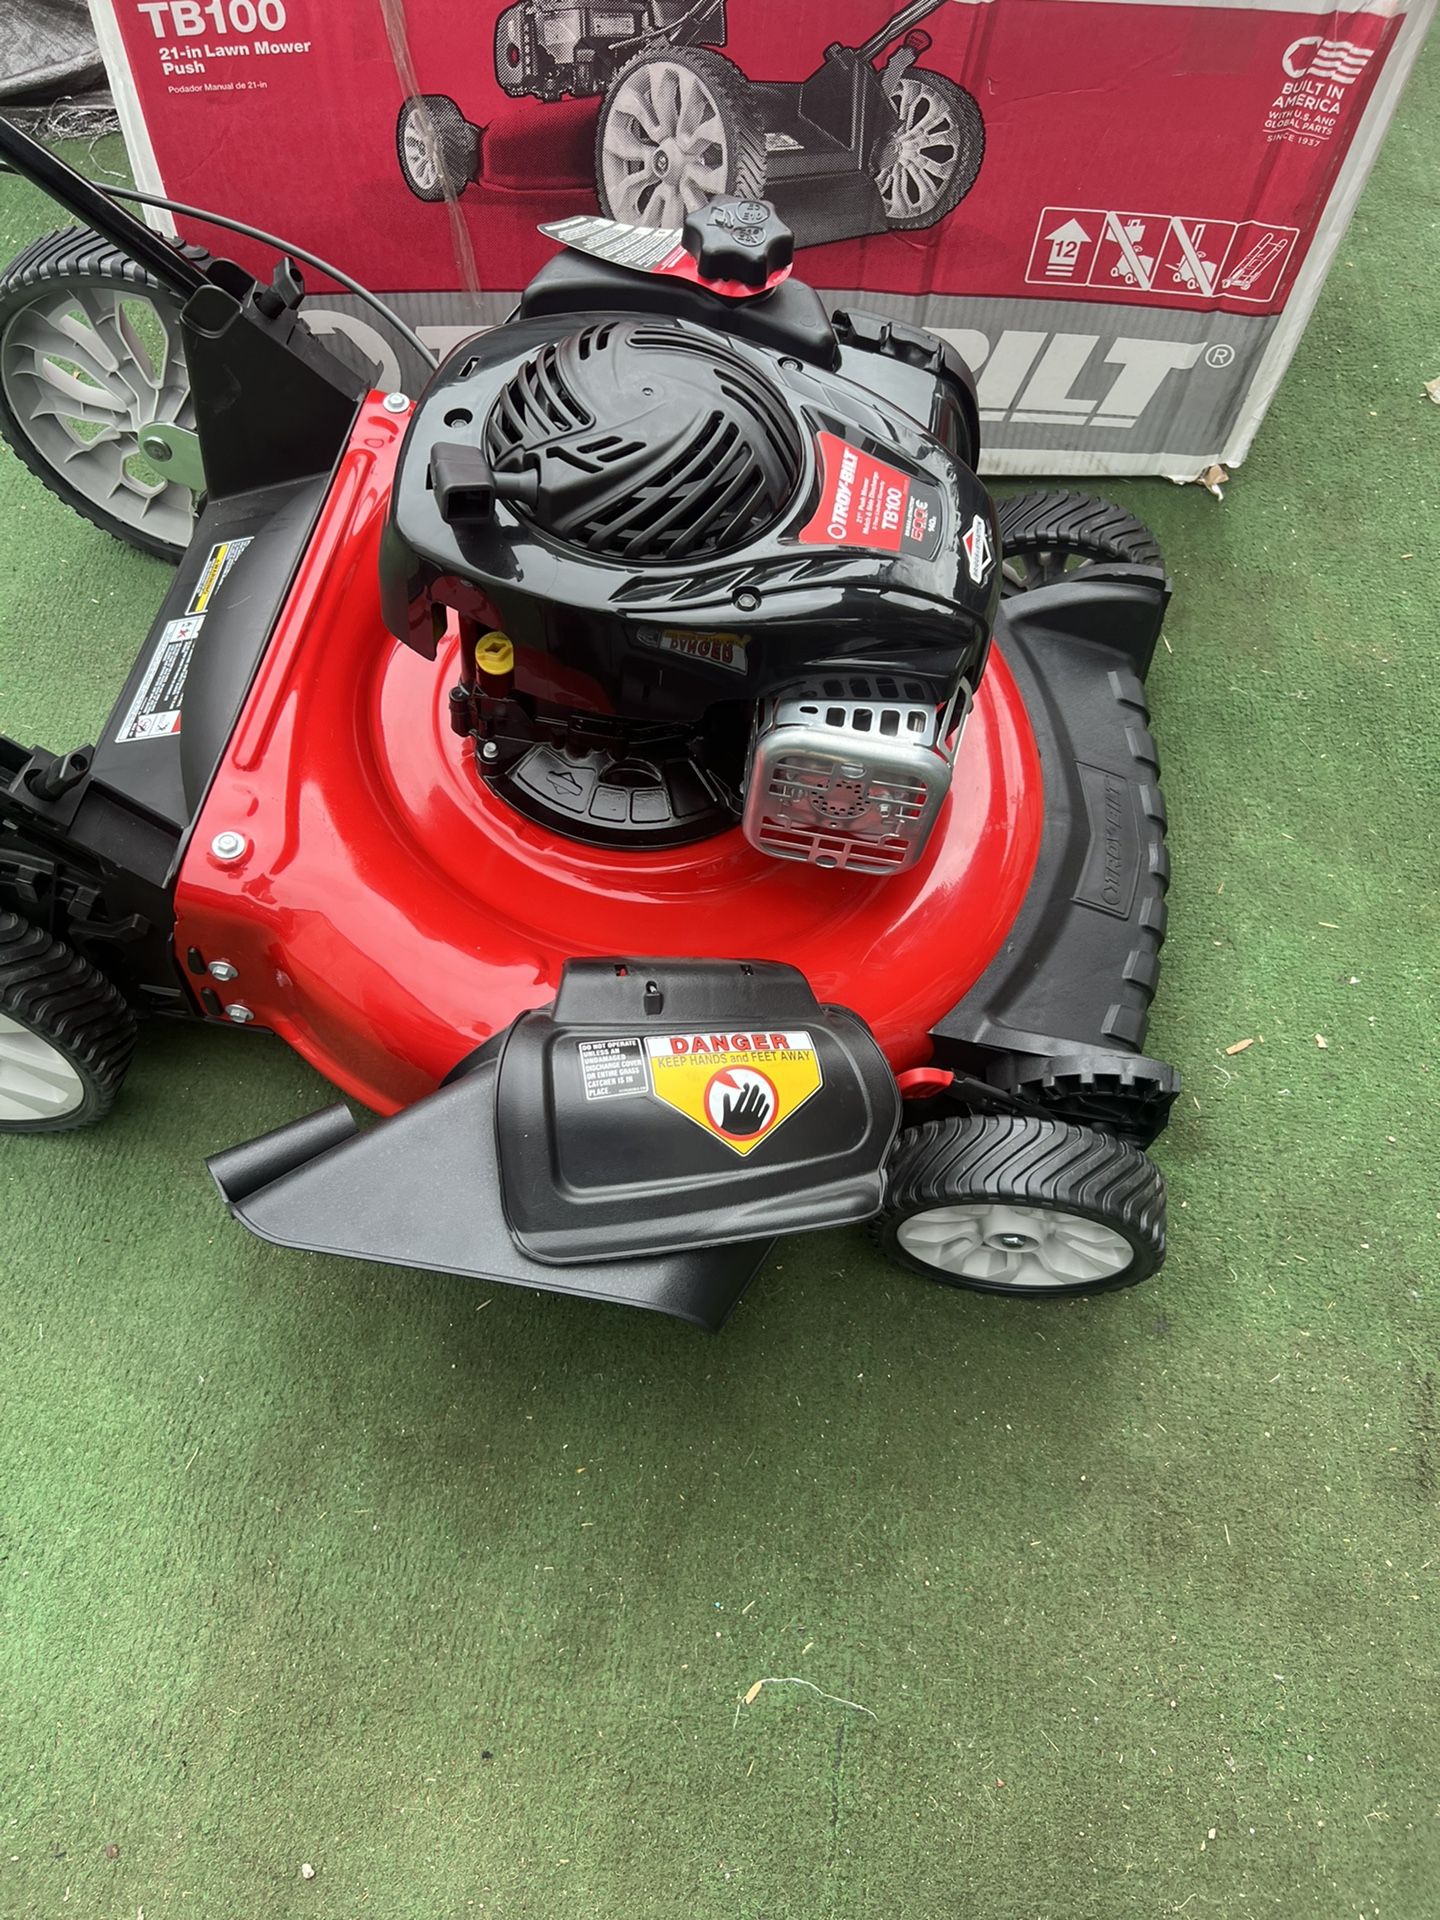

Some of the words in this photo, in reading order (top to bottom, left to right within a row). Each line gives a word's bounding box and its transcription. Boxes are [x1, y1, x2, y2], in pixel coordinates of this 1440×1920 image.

[137, 0, 287, 38] TB100
[159, 44, 202, 61] 21-in
[205, 44, 250, 58] Lawn
[254, 41, 311, 55] Mower
[162, 61, 206, 76] Push
[168, 84, 203, 94] Podador
[204, 82, 234, 92] Manual
[235, 82, 246, 90] de
[247, 81, 268, 89] 21-in
[1282, 79, 1325, 96] BUILT
[1326, 83, 1345, 100] IN
[1272, 94, 1341, 114] AMERICA
[1268, 110, 1293, 119] WITH
[1293, 109, 1311, 121] U.S.
[1313, 115, 1336, 126] AND
[1264, 118, 1299, 129] GLOBAL
[1301, 122, 1333, 135] PARTS
[1267, 132, 1295, 143] SINCE
[1297, 136, 1321, 147] 1937
[1055, 239, 1078, 259] 12
[832, 447, 859, 527] TROY-BILT
[882, 487, 903, 531] TB100
[607, 1040, 637, 1048] OPERATE
[670, 1033, 791, 1055] DANGER
[583, 1049, 609, 1057] UNLESS
[584, 1054, 627, 1064] UNDAMAGED
[658, 1055, 687, 1069] KEEP
[691, 1053, 727, 1066] HANDS
[730, 1052, 748, 1063] and
[751, 1050, 777, 1062] FEET
[781, 1050, 812, 1061] AWAY
[586, 1061, 620, 1072] DISCHARGE
[621, 1059, 642, 1068] COVER
[597, 1069, 619, 1079] ENTIRE
[619, 1066, 640, 1075] GRASS
[588, 1078, 617, 1088] CATCHER
